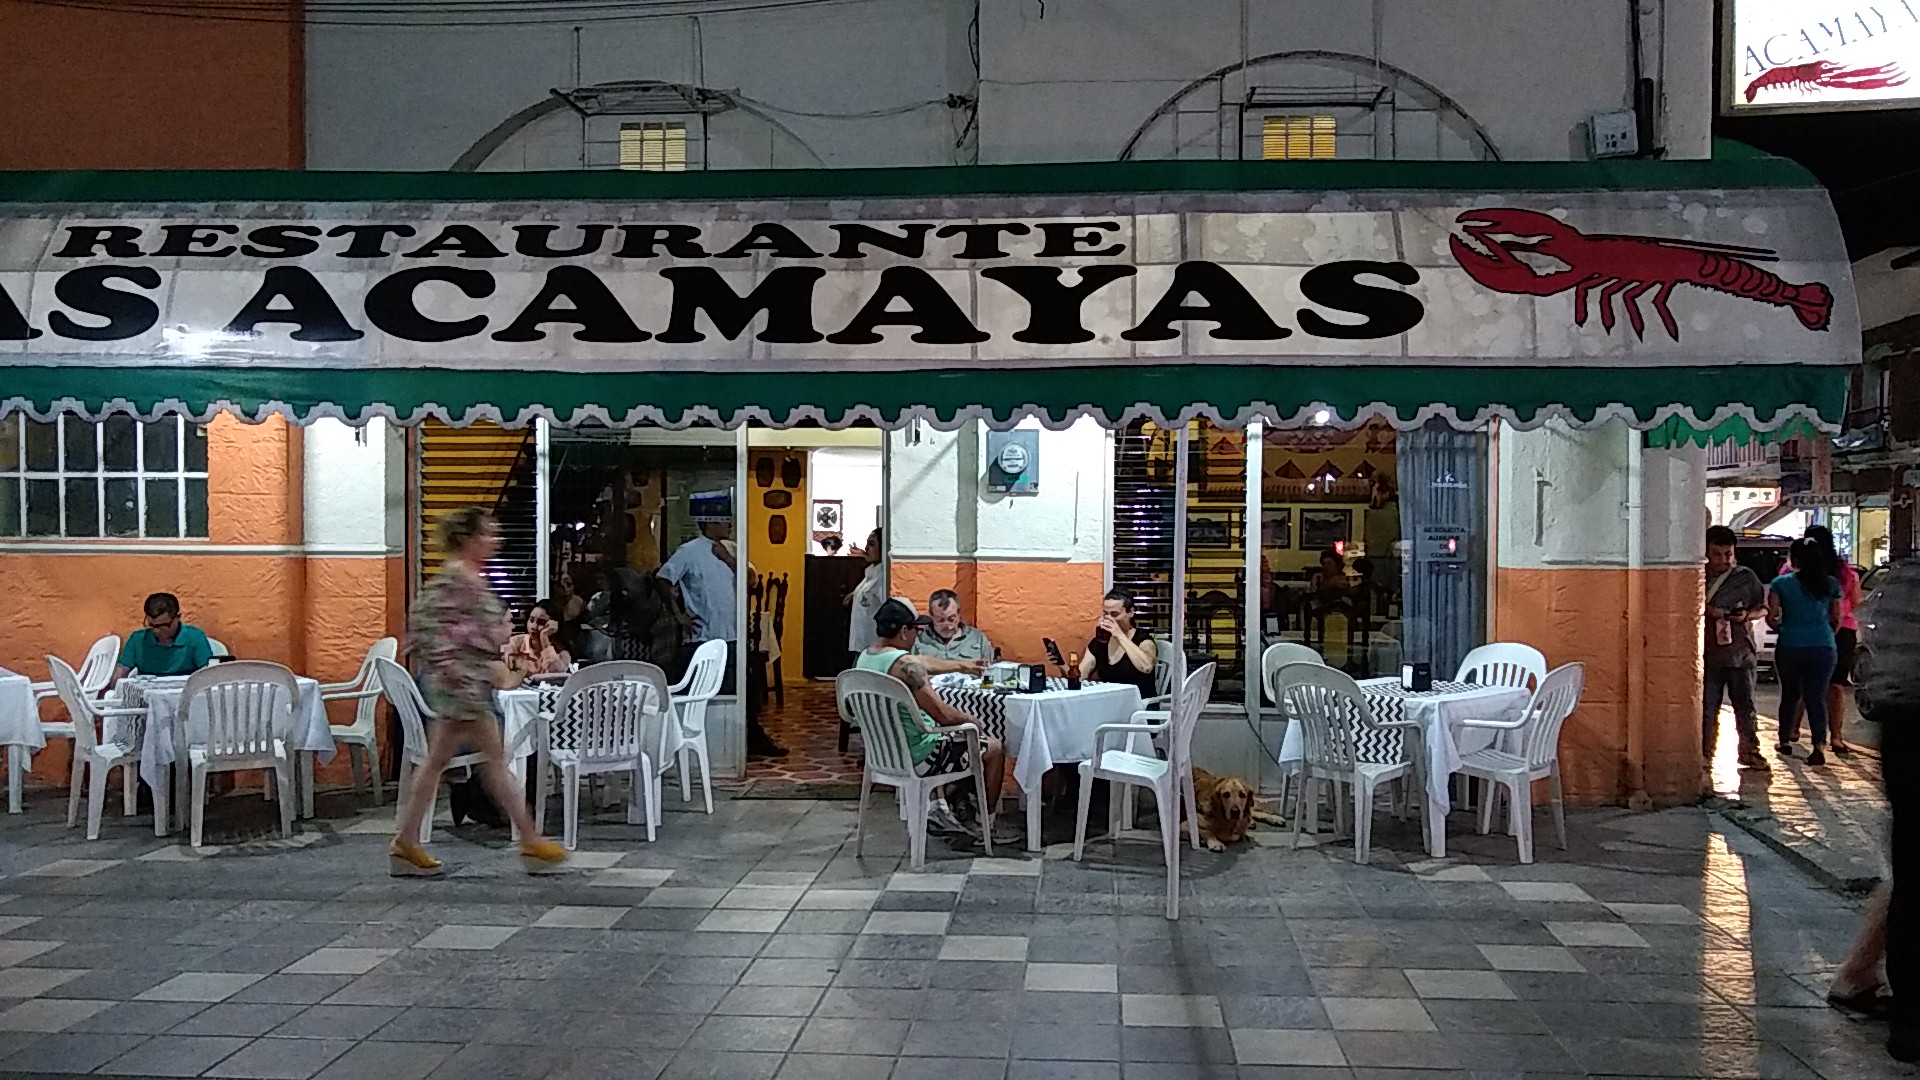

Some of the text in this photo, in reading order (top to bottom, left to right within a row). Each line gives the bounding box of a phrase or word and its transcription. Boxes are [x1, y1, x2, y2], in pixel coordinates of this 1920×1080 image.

[51, 221, 1127, 260] RESTAURANTE
[0, 259, 1425, 345] S ACAMAYAS
[1792, 495, 1854, 506] TOPACIO
